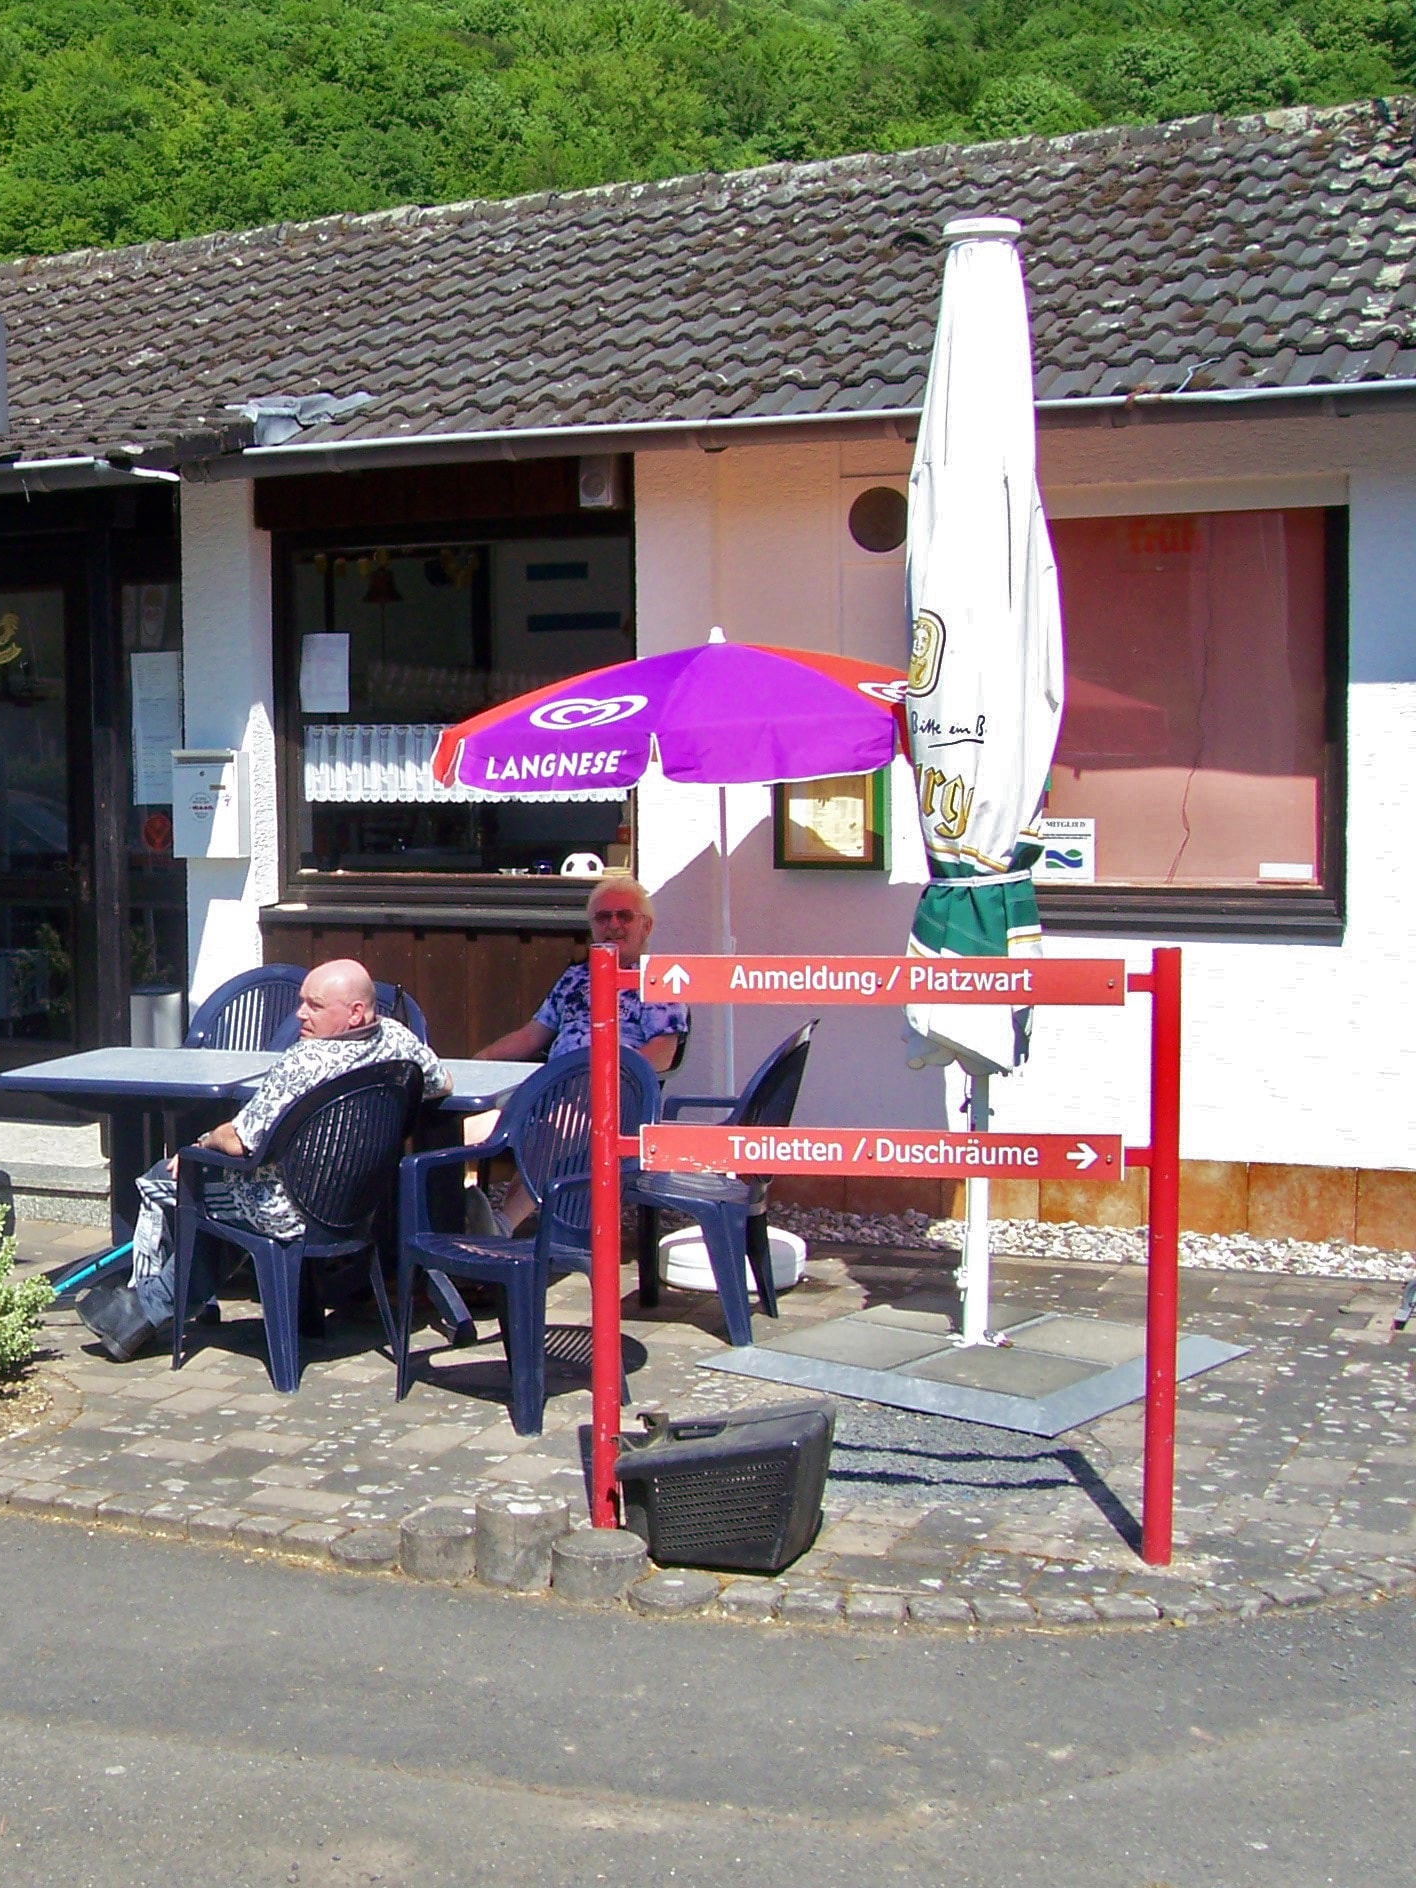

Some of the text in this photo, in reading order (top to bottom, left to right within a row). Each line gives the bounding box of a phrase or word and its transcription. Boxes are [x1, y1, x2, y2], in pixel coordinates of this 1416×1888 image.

[911, 711, 942, 735] Bitte
[485, 750, 627, 781] LANGNESE
[729, 964, 1033, 995] Anmeldung / Platzwart
[727, 1135, 1039, 1166] Toiletten / Duschräume
